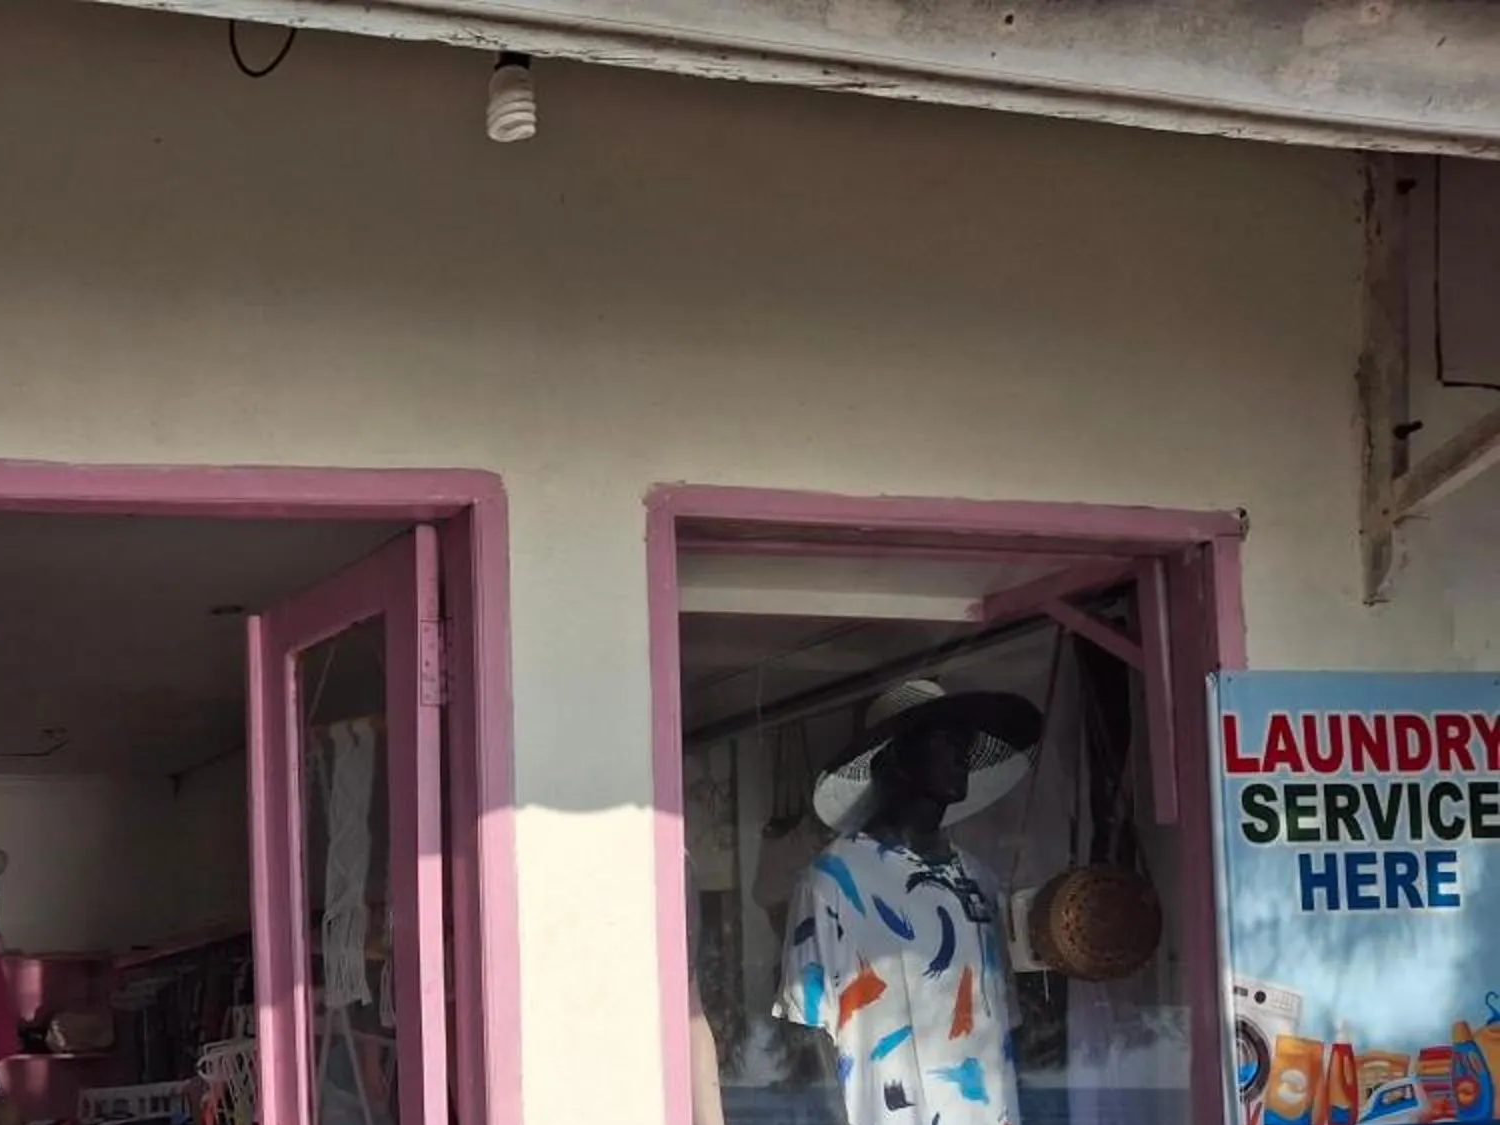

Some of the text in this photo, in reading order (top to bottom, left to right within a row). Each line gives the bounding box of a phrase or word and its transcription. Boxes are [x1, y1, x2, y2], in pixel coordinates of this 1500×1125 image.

[1222, 713, 1500, 774] LAUNDRY
[1240, 782, 1500, 844] SERVICE
[1299, 850, 1461, 912] HERE
